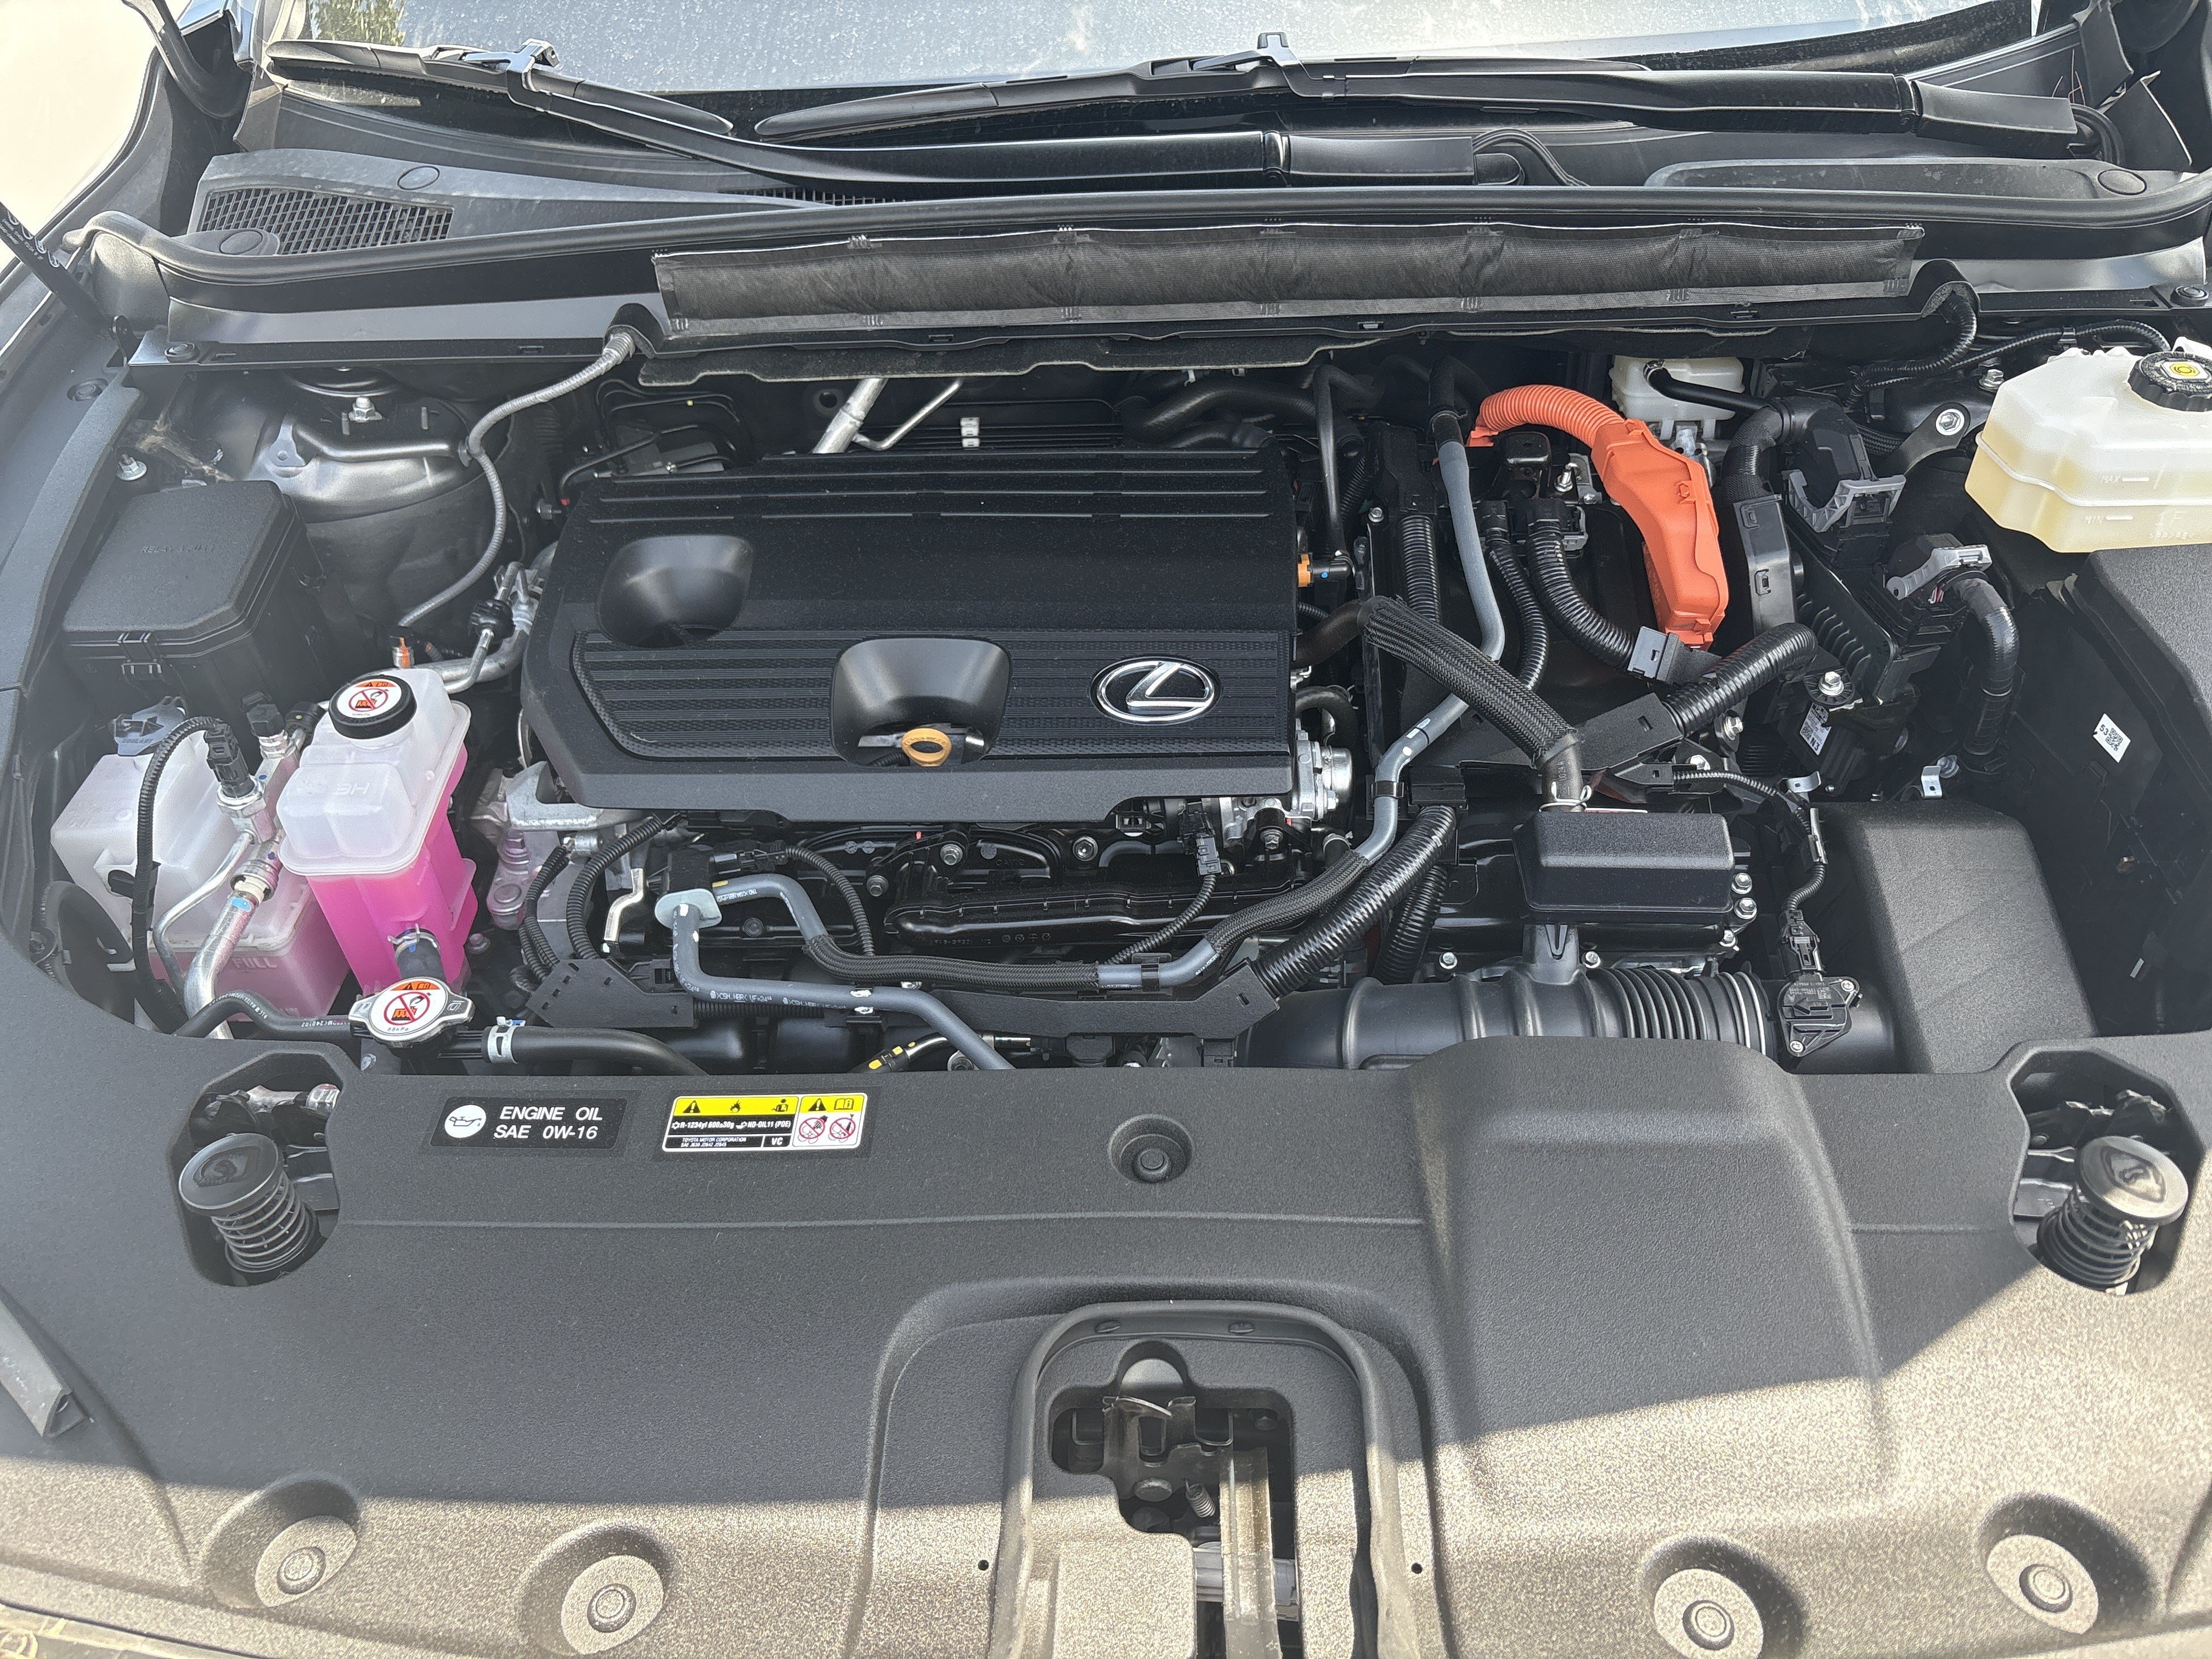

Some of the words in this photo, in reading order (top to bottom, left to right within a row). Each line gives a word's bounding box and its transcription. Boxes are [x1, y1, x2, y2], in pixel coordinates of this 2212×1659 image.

[2100, 724, 2109, 736] 53
[1810, 737, 1820, 751] N3
[500, 1106, 566, 1120] ENGINE
[575, 1107, 603, 1121] OIL
[494, 1124, 532, 1138] SAE
[543, 1125, 599, 1139] 0W-16
[771, 1137, 783, 1146] VC
